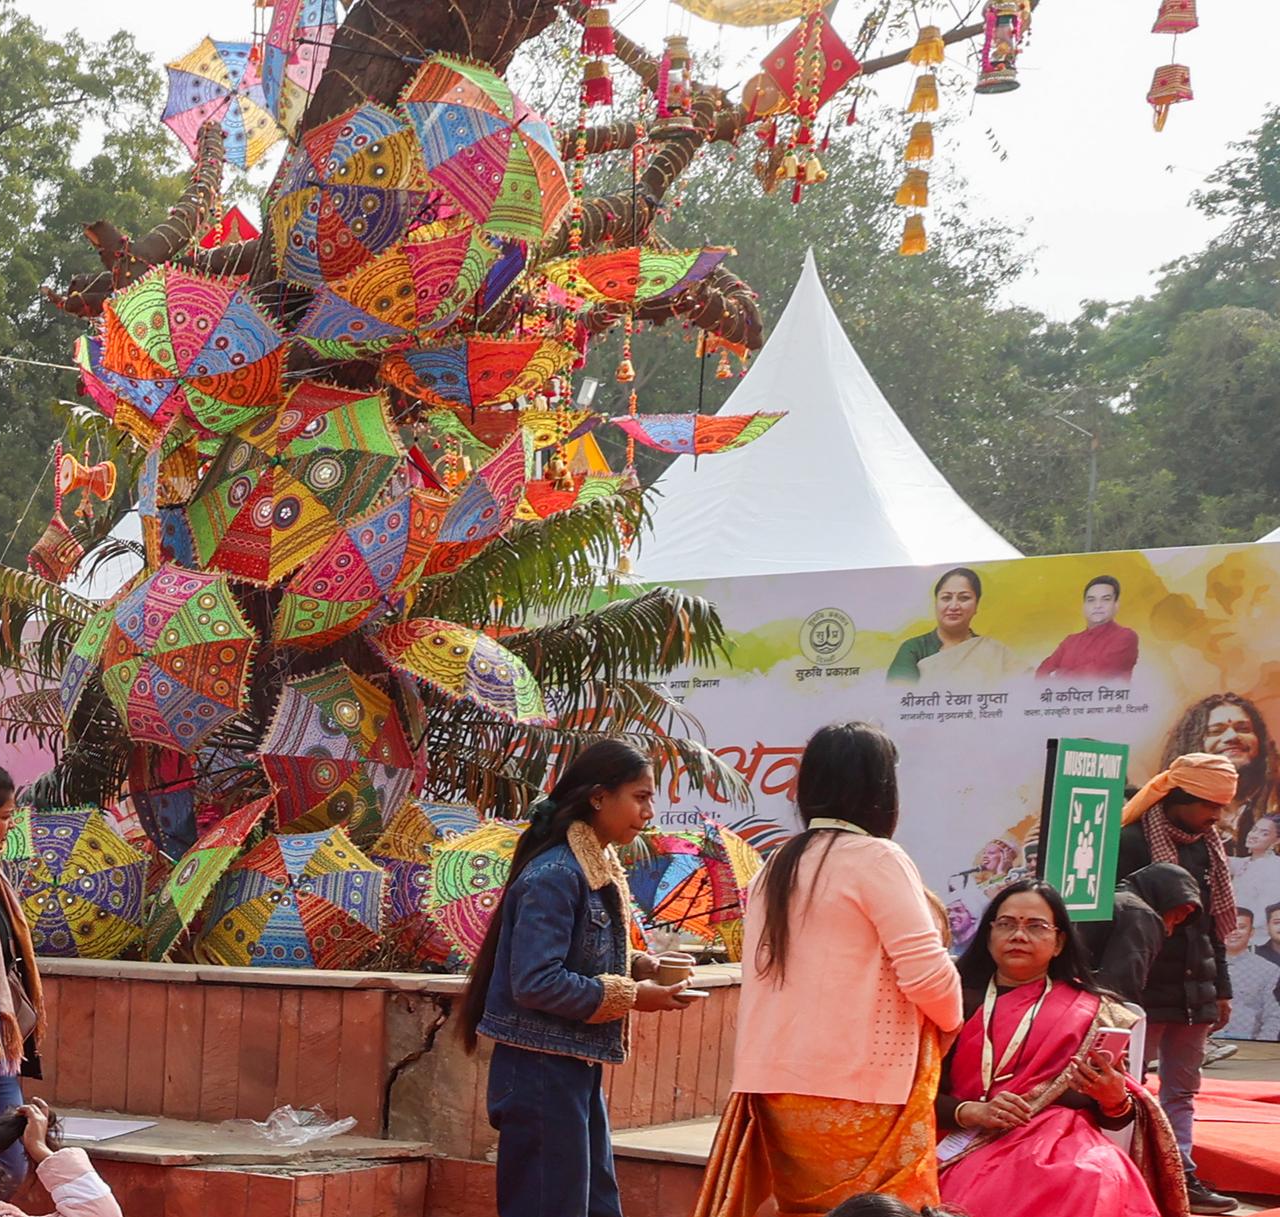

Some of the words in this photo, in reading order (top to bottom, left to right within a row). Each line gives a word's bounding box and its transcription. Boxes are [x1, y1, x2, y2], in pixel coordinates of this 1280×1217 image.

[795, 665, 823, 682] सुरुचि
[900, 690, 941, 708] श्रीमती
[944, 690, 973, 706] रेखा
[976, 692, 1009, 710] गुप्ता
[1039, 687, 1053, 703] श्री
[1055, 686, 1094, 702] कपिल
[1097, 685, 1130, 701] मिश्रा
[1062, 750, 1098, 778] MUSTER
[1097, 752, 1123, 779] POINT
